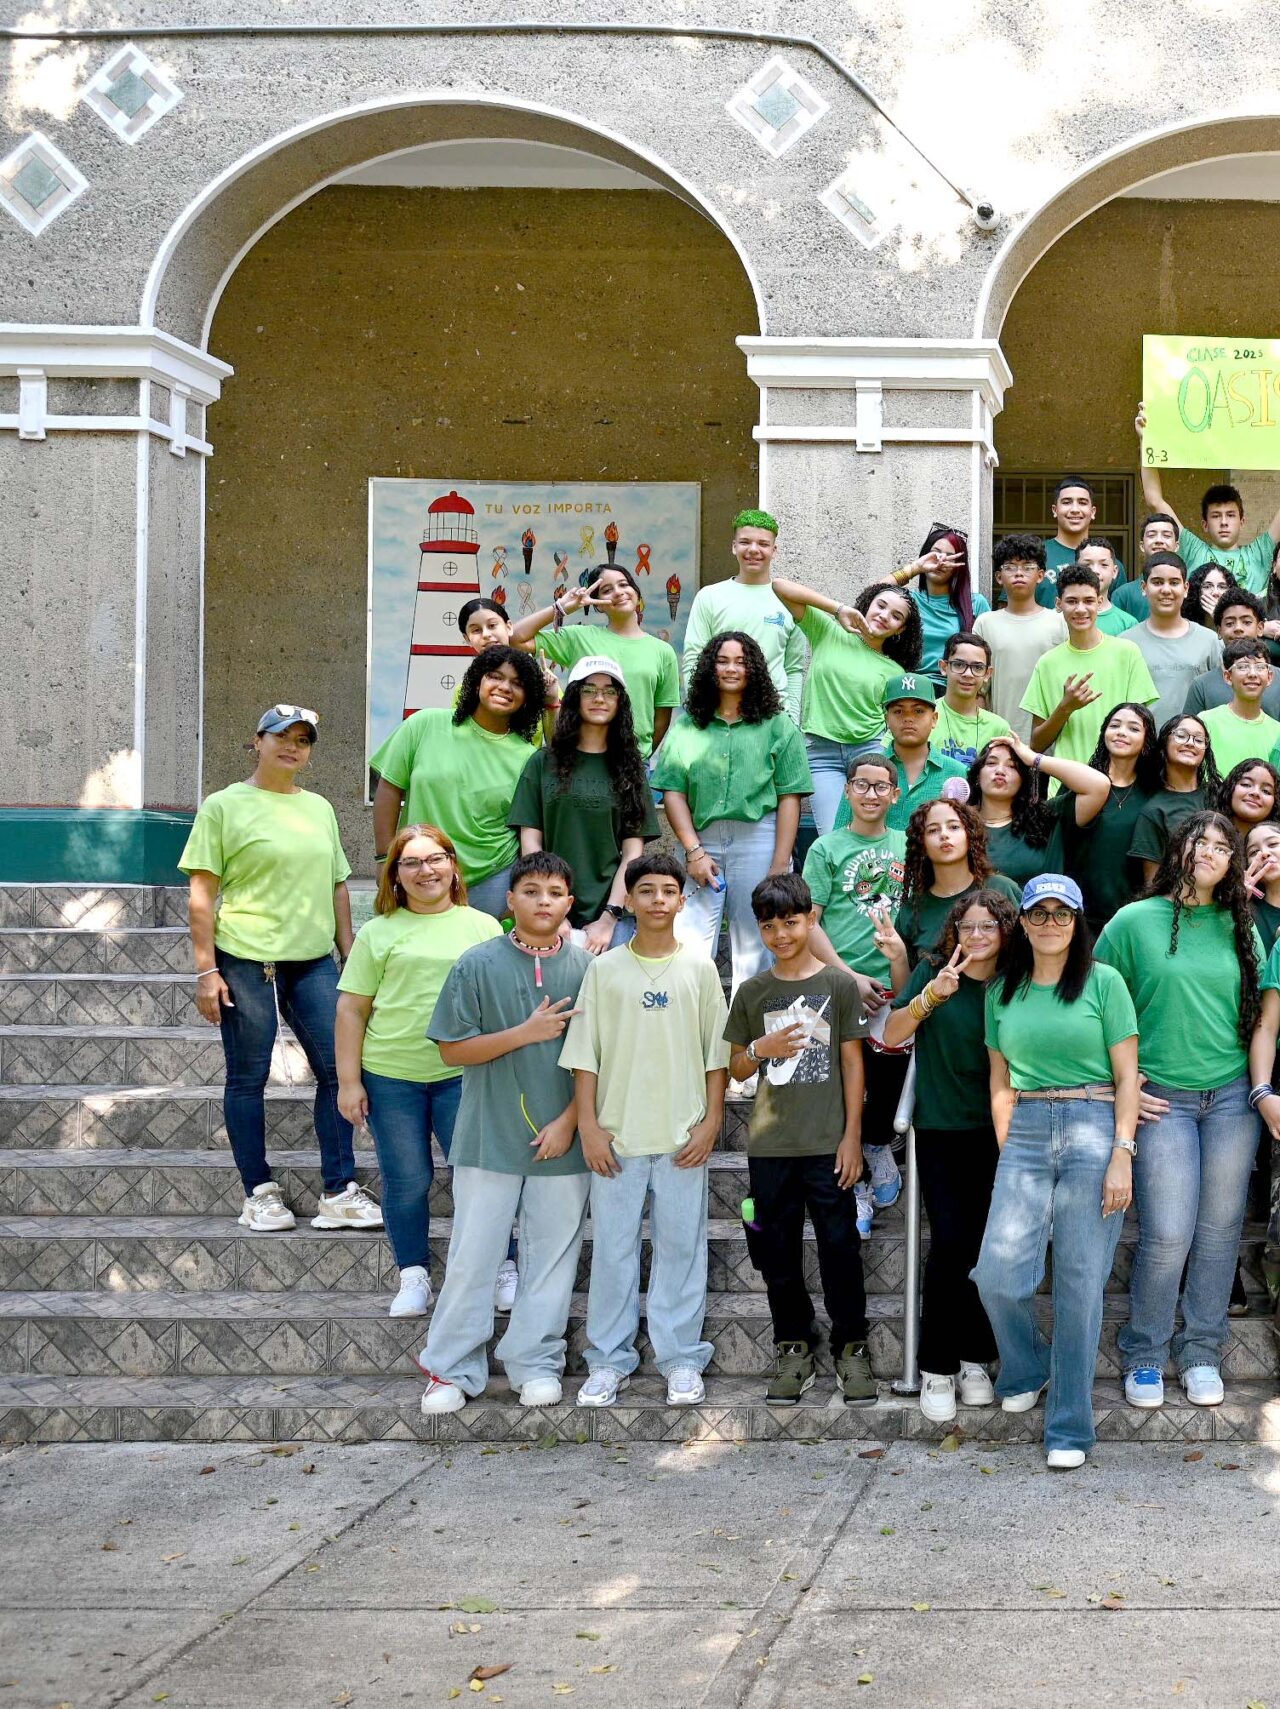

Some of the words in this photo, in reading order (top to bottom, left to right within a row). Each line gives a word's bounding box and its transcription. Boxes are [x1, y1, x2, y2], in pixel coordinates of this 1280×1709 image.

[1187, 347, 1226, 362] CLASE
[485, 504, 503, 514] TU
[512, 504, 541, 515] VOZ
[548, 503, 612, 513] IMPORTA
[890, 866, 903, 874] TNT
